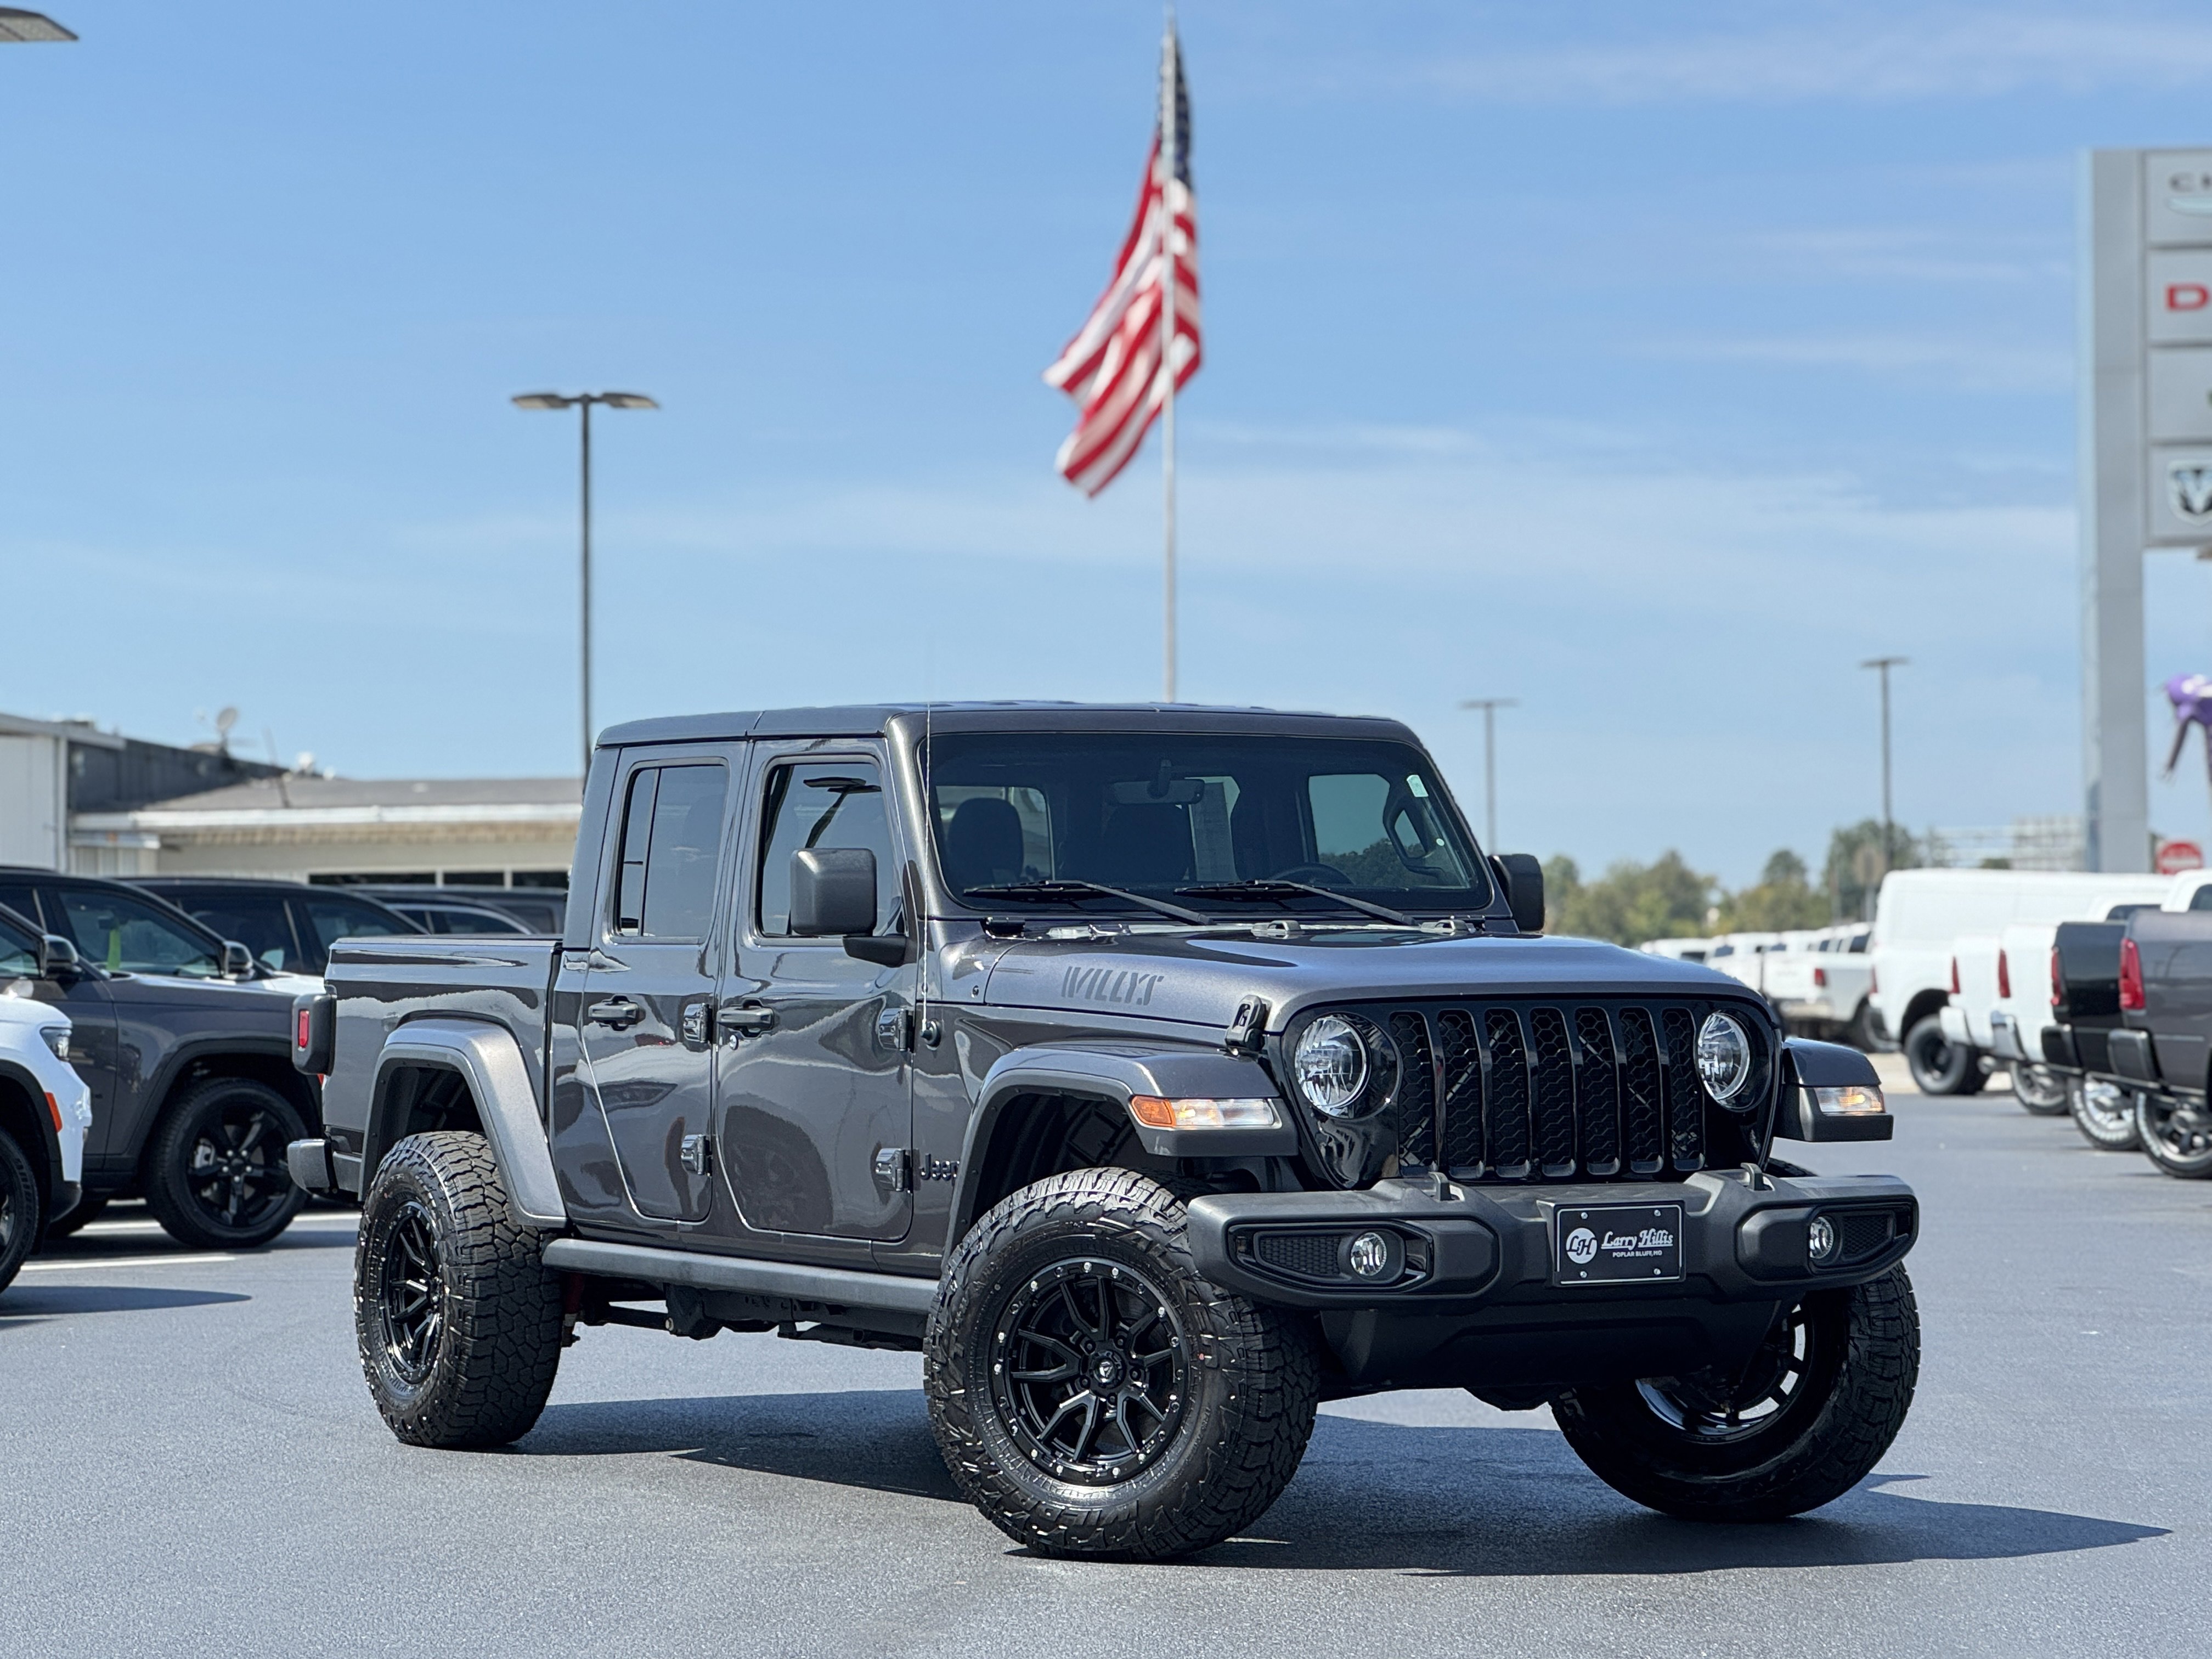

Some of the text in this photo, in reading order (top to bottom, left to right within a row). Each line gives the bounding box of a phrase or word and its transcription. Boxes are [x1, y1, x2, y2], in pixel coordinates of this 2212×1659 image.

[1061, 966, 1164, 1006] WILLYS
[1601, 1228, 1673, 1250] Larry Hillis
